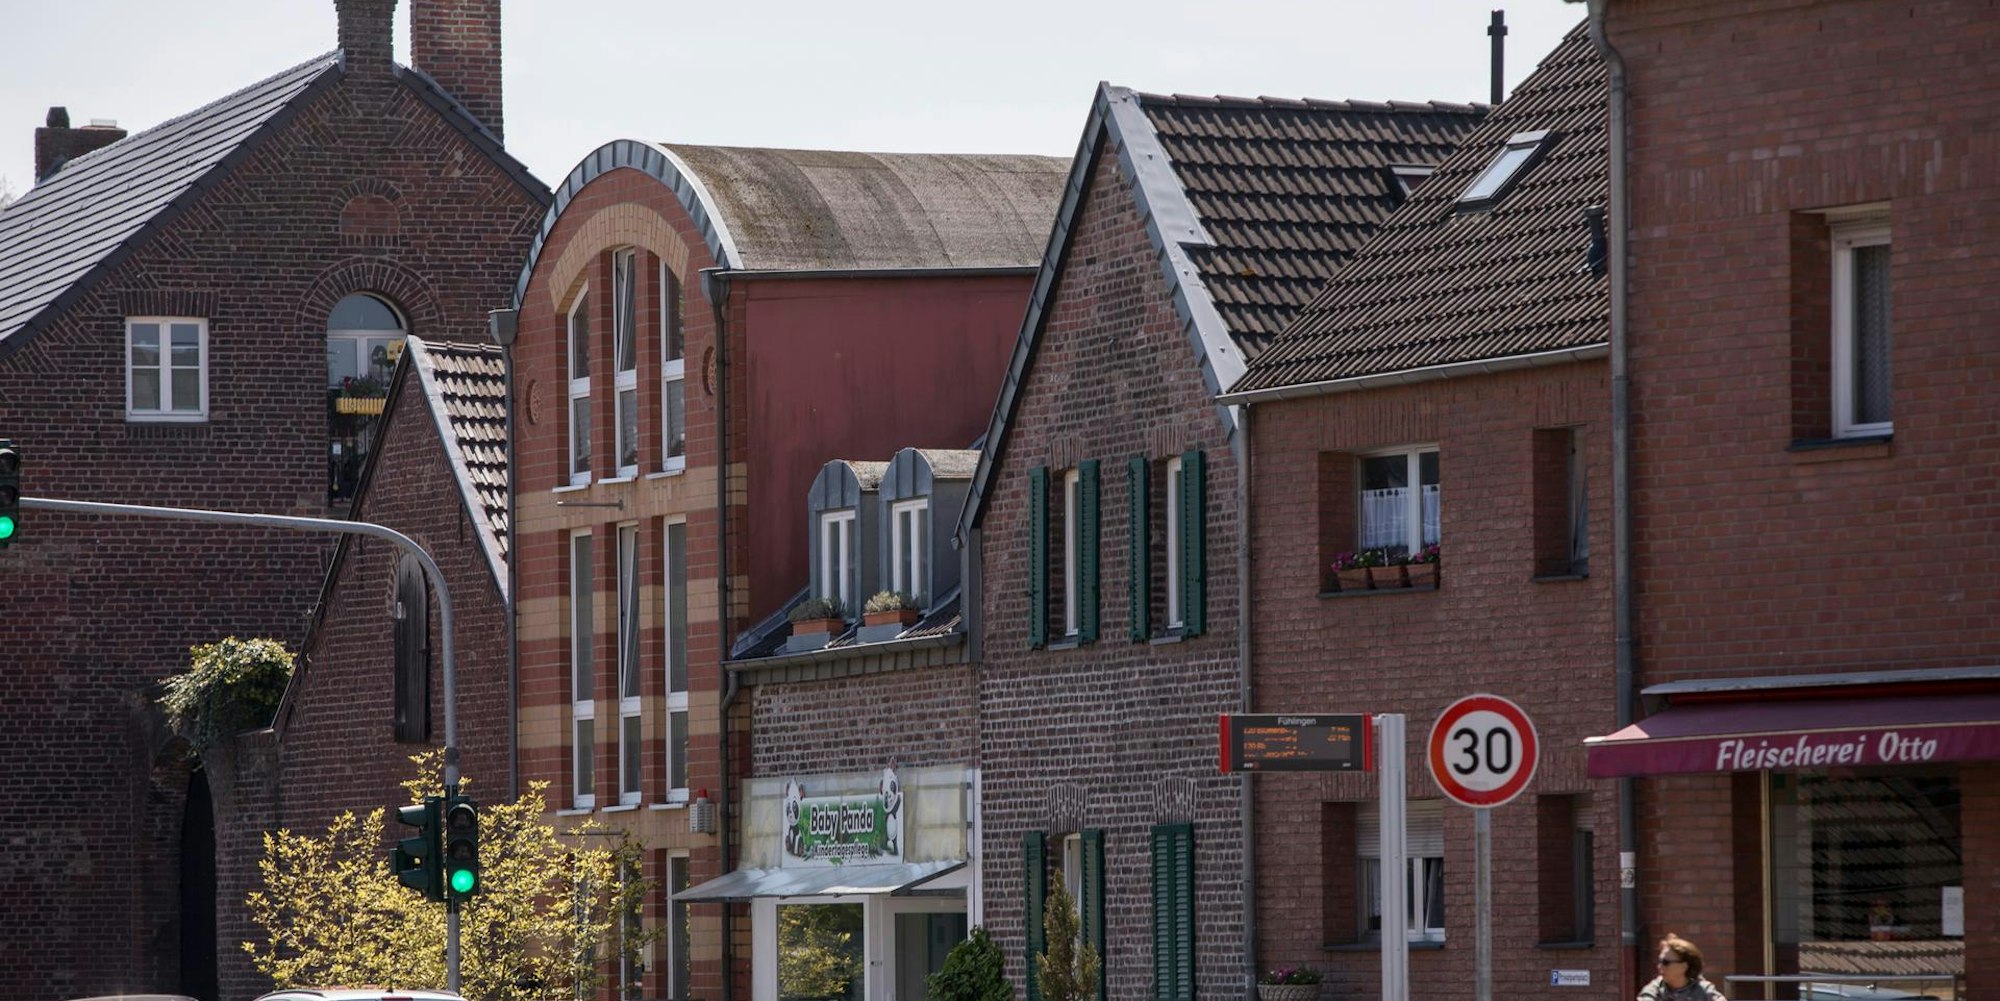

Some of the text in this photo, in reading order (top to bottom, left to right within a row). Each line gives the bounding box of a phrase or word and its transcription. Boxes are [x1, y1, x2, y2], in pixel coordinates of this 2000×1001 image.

[1277, 717, 1317, 726] Fühlingen
[1453, 727, 1512, 775] 30
[1716, 731, 1938, 770] Fleischerei Otto
[810, 803, 874, 838] Baby Panda
[814, 840, 869, 859] Kindertagespflege
